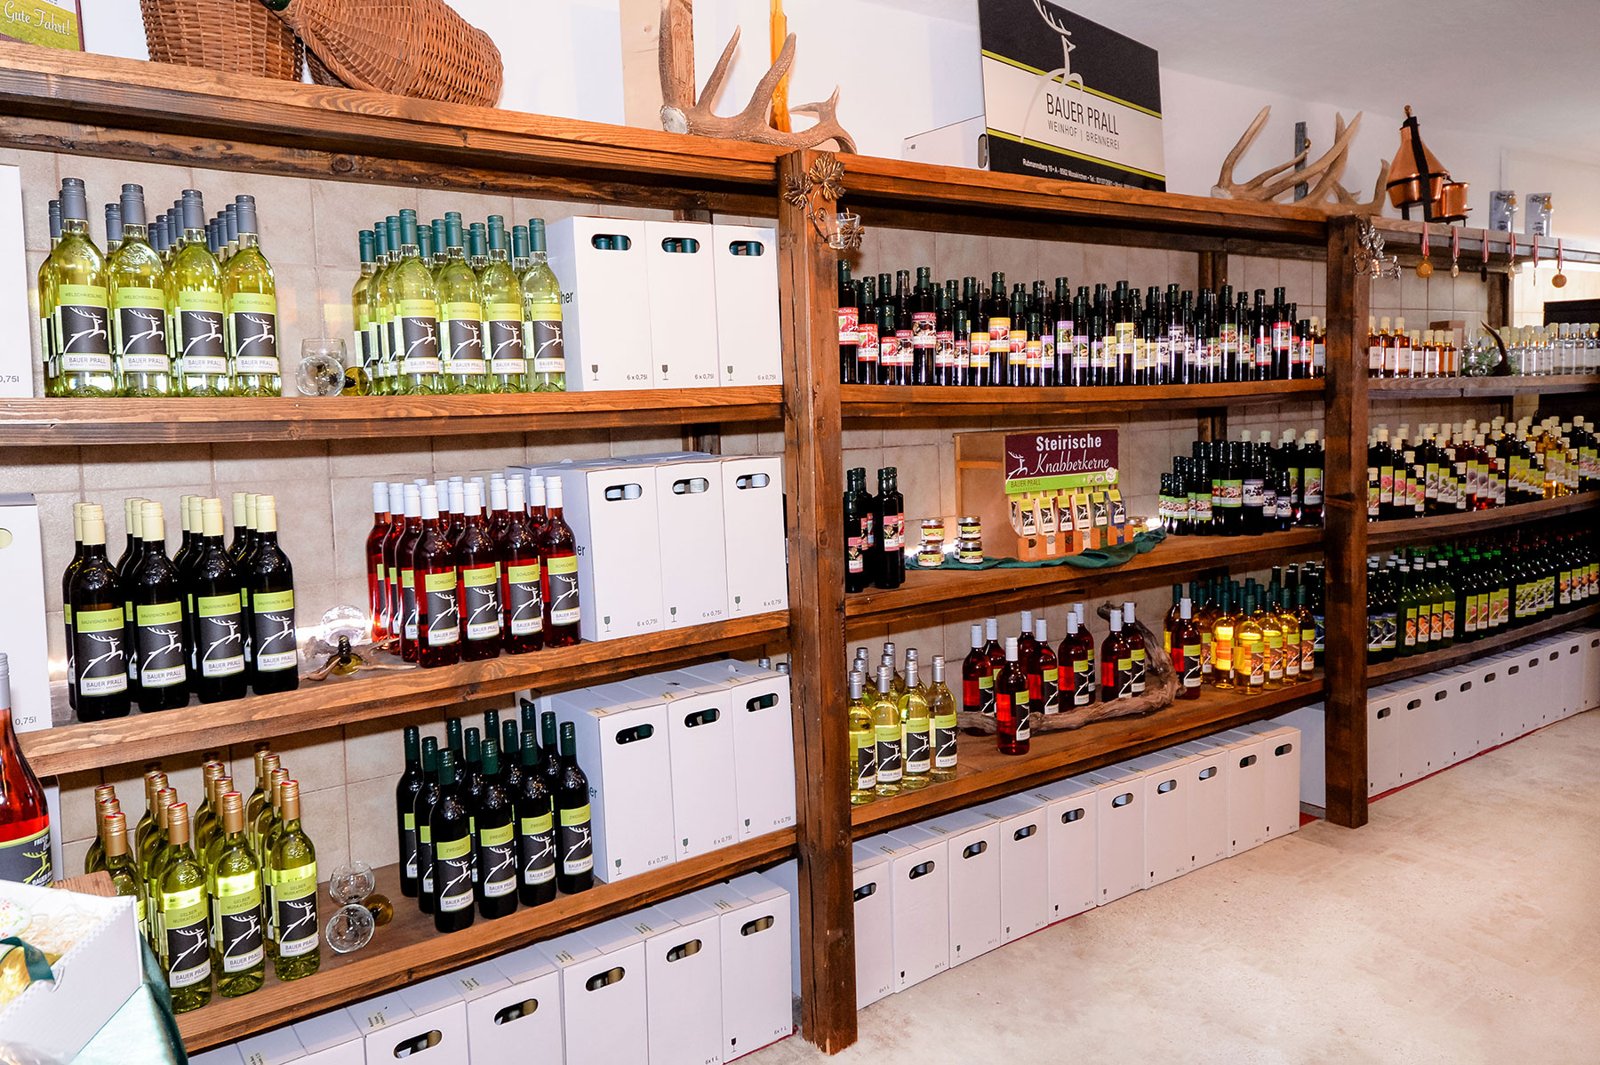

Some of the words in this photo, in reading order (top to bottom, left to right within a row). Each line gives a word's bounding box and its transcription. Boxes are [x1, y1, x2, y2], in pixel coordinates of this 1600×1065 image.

[4, 1, 31, 23] Gute
[34, 8, 71, 36] Fahrt!
[1046, 92, 1084, 125] BAUER
[1087, 106, 1119, 136] PRALL
[1048, 120, 1077, 137] WEINHOF
[1086, 131, 1119, 150] BRENNEREI
[148, 357, 164, 365] PRALL
[1036, 433, 1102, 452] Steirische
[1030, 449, 1110, 475] Knabberkerne
[194, 968, 207, 976] PRALL
[230, 957, 247, 965] BAUER
